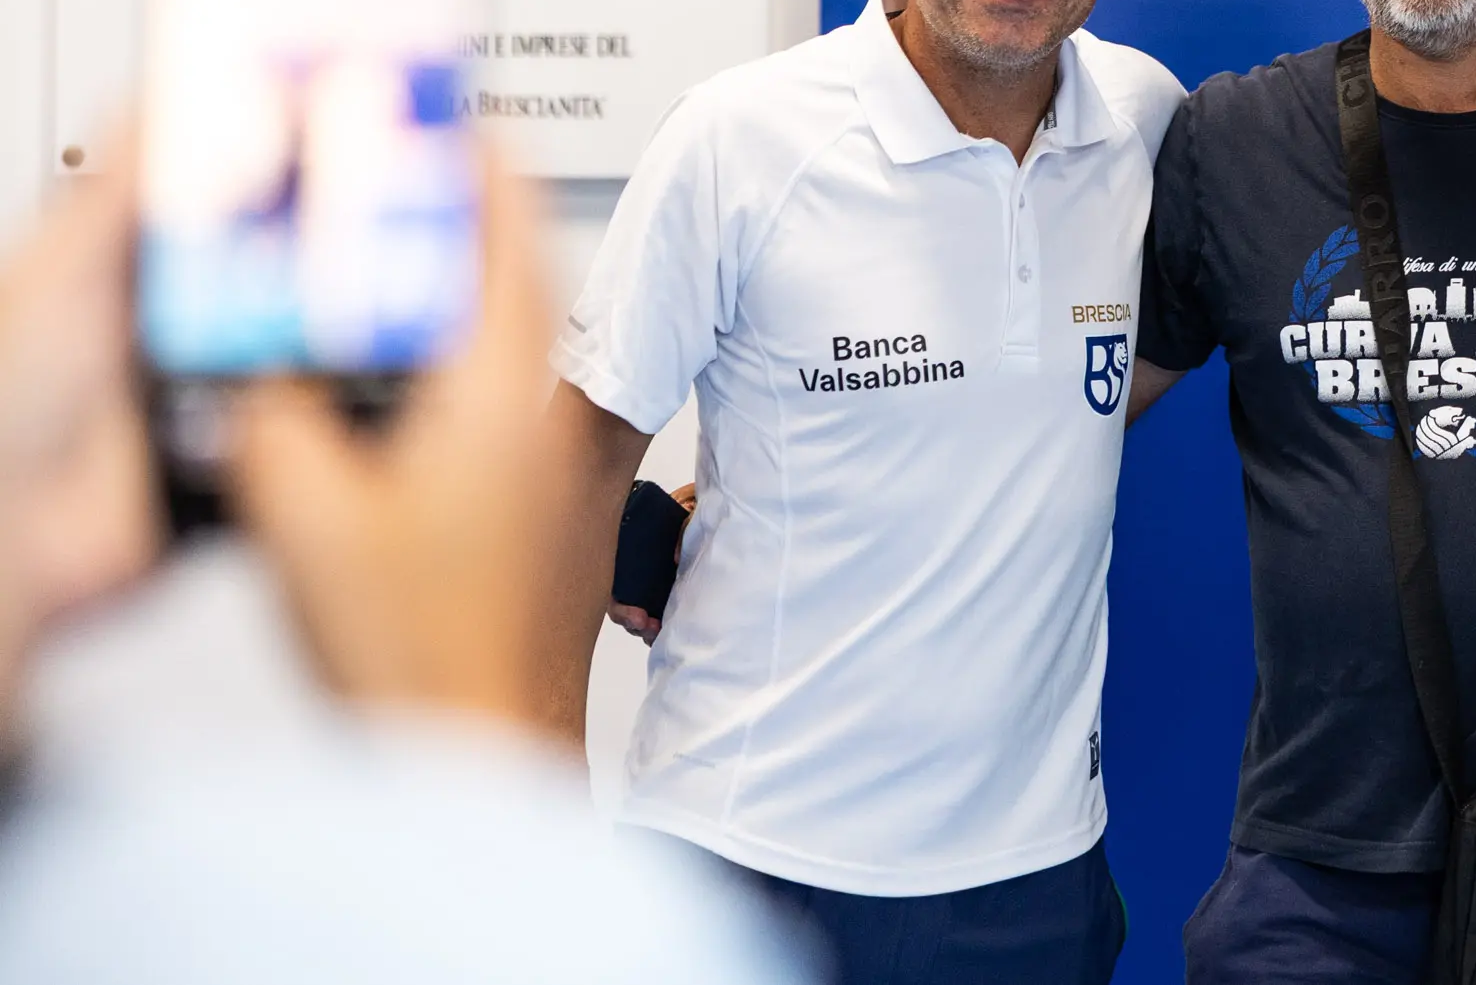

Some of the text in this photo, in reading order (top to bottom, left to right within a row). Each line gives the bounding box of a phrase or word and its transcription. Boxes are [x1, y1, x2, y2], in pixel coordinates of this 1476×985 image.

[1438, 256, 1459, 272] di
[1071, 303, 1132, 324] BRESCIA
[832, 333, 928, 362] Banca
[799, 358, 966, 393] Valsabbina
